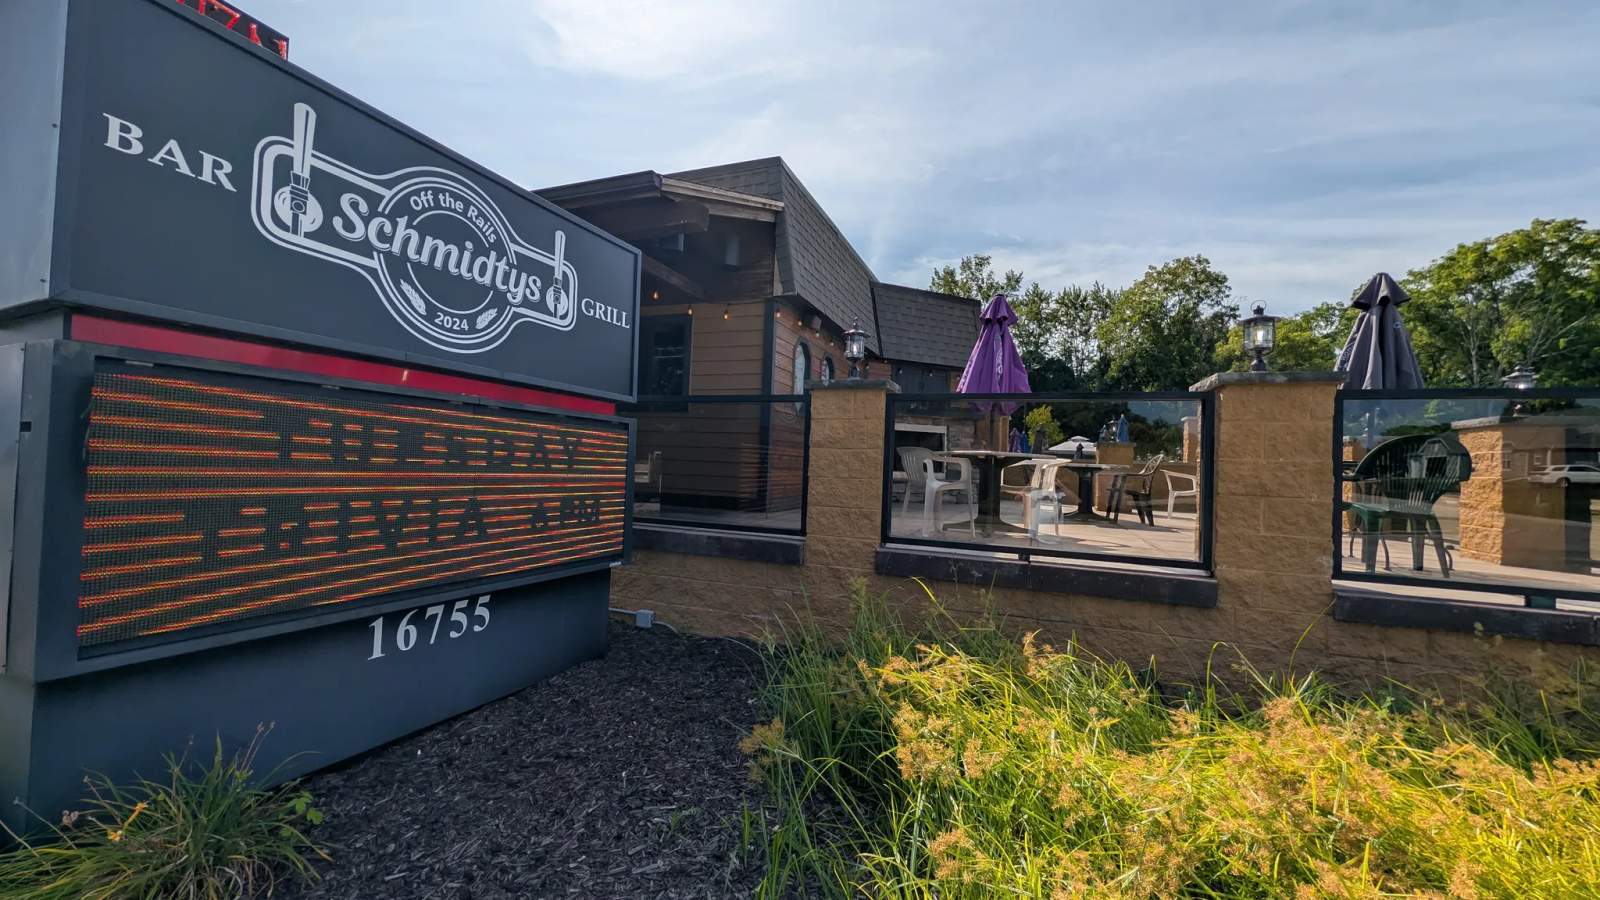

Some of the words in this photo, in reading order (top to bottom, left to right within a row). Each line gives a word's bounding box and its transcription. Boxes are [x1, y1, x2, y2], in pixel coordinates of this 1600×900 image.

[102, 112, 237, 192] BAR
[409, 190, 435, 212] Off
[438, 191, 464, 212] the
[467, 206, 497, 244] Rails
[332, 192, 542, 305] Schmidtys
[434, 311, 469, 331] 2024
[581, 297, 631, 329] GRILL
[367, 594, 491, 660] 16755
